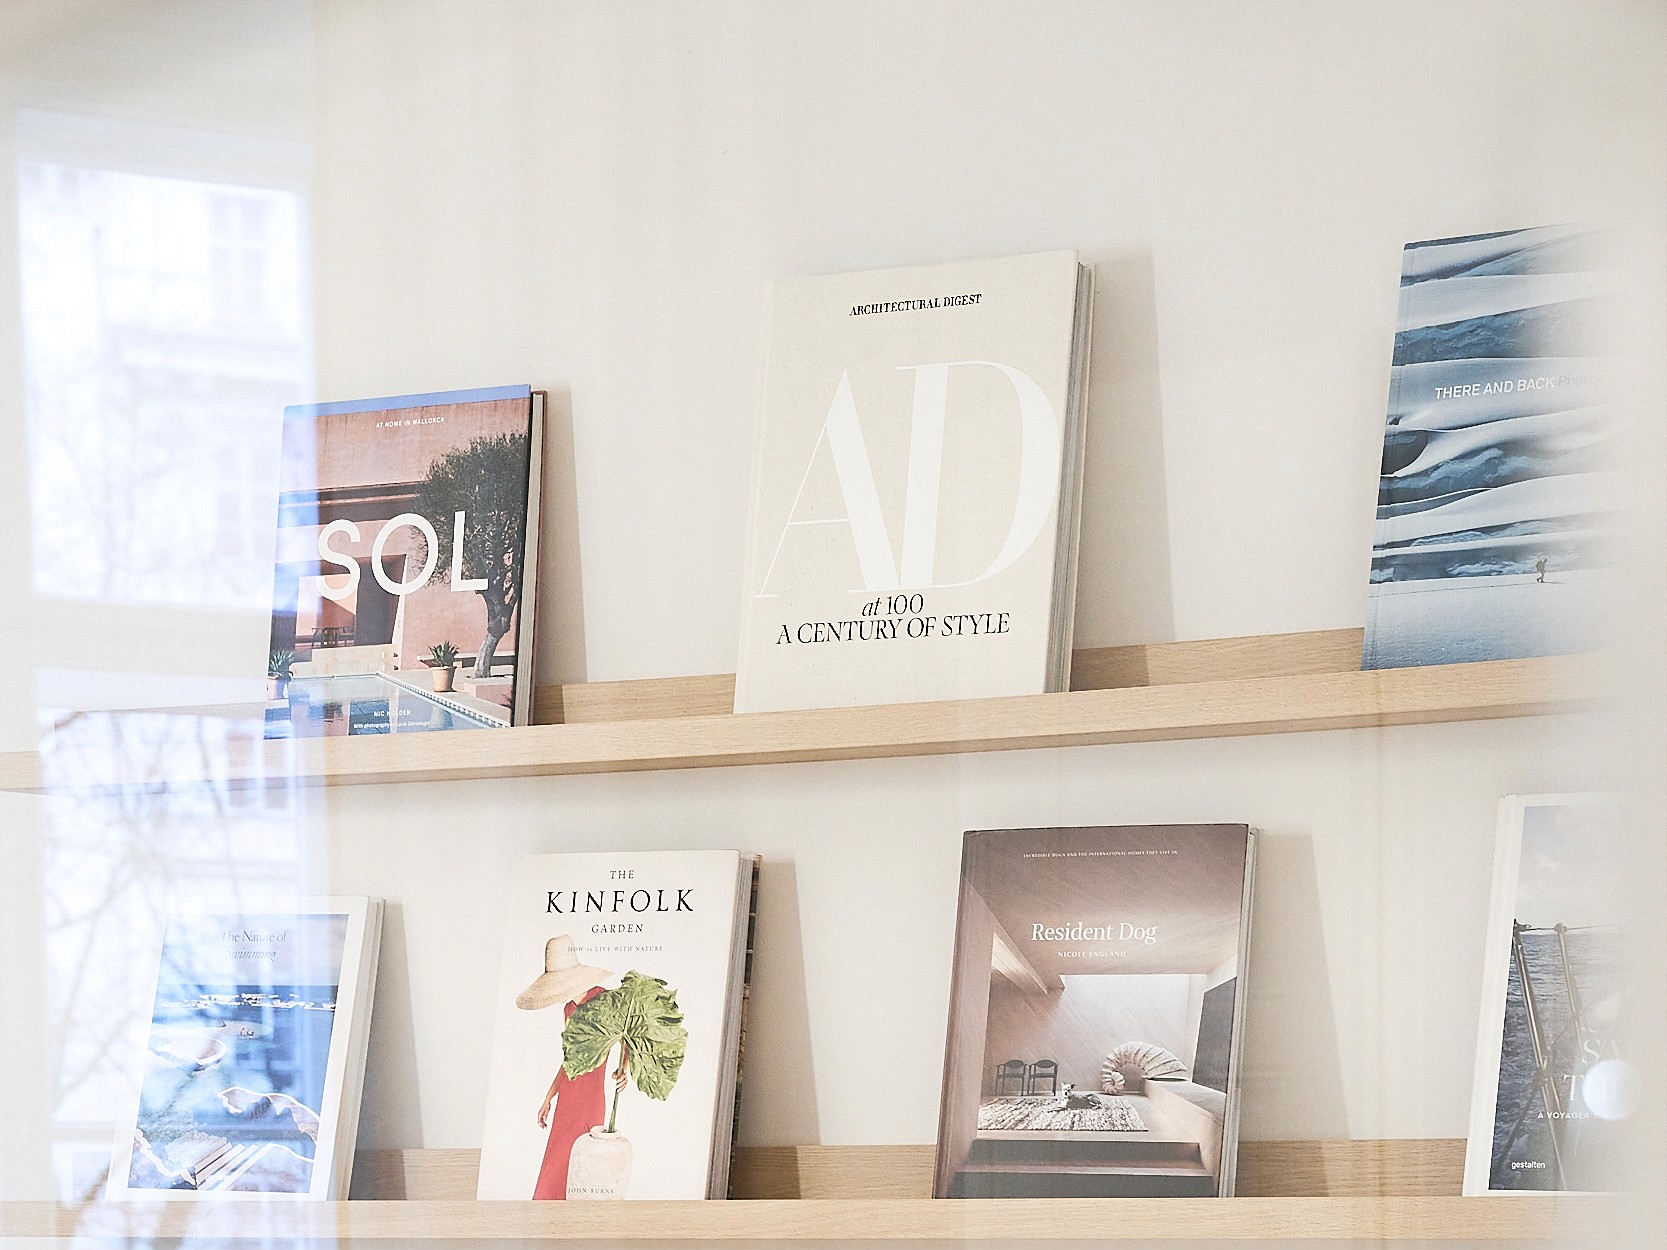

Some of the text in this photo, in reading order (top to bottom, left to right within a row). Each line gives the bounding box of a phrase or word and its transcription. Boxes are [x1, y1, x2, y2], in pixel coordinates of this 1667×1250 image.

[849, 293, 982, 317] ARCHITECTURAL DIGEST
[1434, 383, 1481, 400] THERE
[1483, 380, 1514, 396] AND
[1516, 376, 1555, 392] BACK
[412, 416, 445, 425] MALLORCA
[754, 360, 1061, 599] AD
[315, 510, 489, 601] SOL
[862, 593, 924, 617] at 100
[776, 612, 1010, 645] A CENTURY OF STYLE
[610, 869, 635, 879] THE
[545, 889, 694, 914] KINFOLK
[221, 929, 240, 942] The
[276, 929, 289, 942] of
[591, 923, 643, 934] GARDEN
[1030, 921, 1158, 945] Resident Dog
[1537, 1111, 1544, 1119] A
[1511, 1160, 1546, 1170] gestalten
